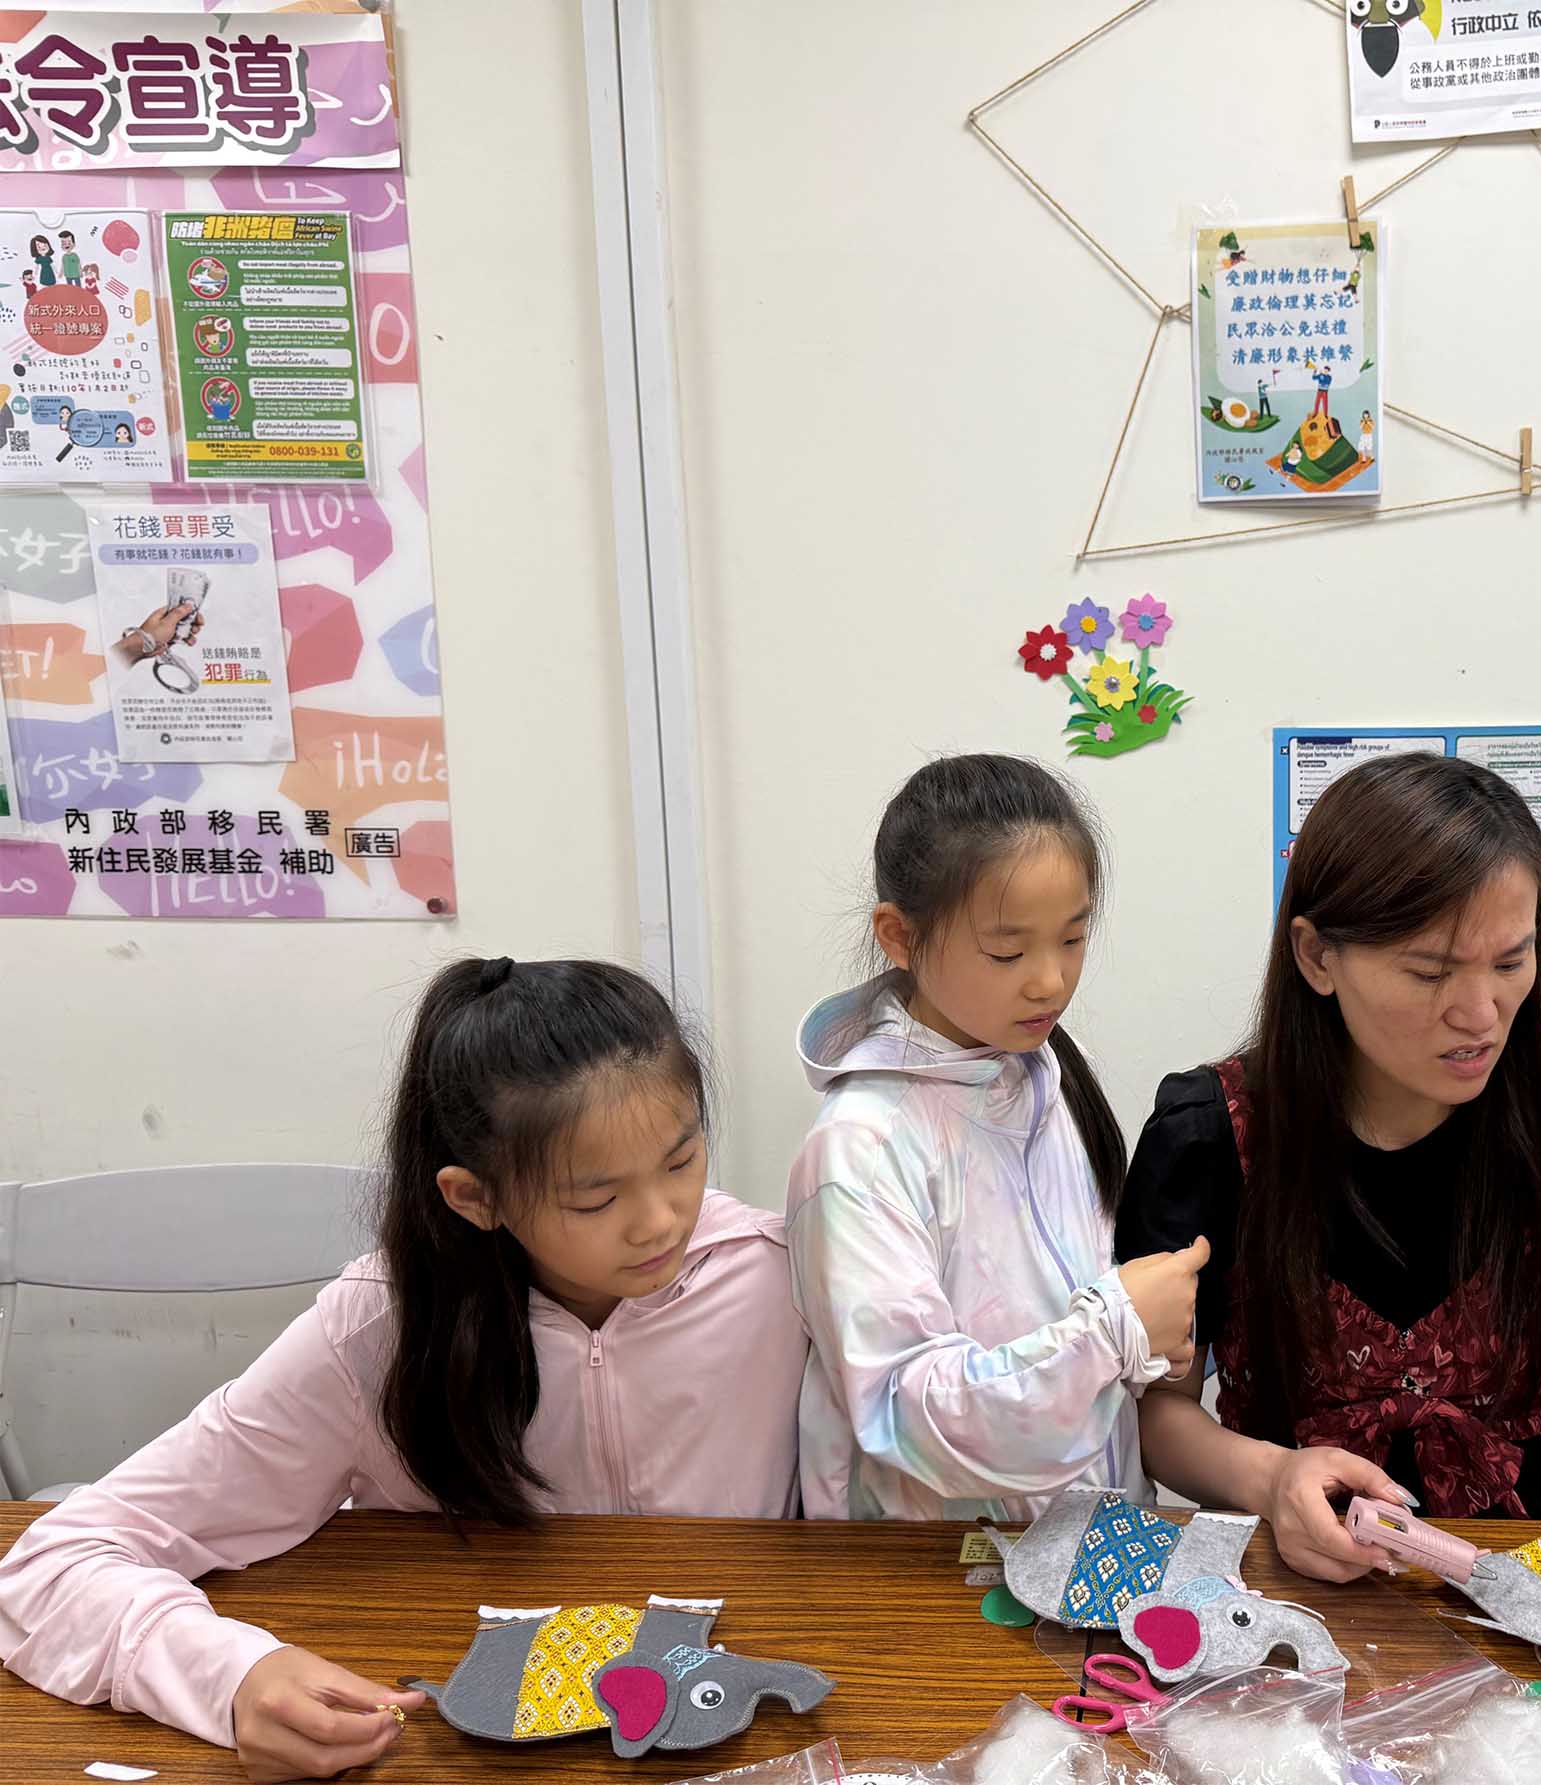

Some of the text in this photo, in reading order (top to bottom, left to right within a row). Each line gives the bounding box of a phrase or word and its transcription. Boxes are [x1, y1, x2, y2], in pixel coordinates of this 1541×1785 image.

[1451, 12, 1519, 36] 行政中立
[0, 35, 300, 139] 令宣導
[1226, 267, 1347, 287] 受贈財物想仔細
[269, 445, 339, 458] 0800-039-131
[113, 514, 236, 539] 花錢買罪受
[205, 662, 268, 682] 犯罪行為
[65, 808, 332, 836] 內政部移民署
[351, 832, 396, 855] 廣告
[68, 847, 334, 875] 新住民發展基金 補助
